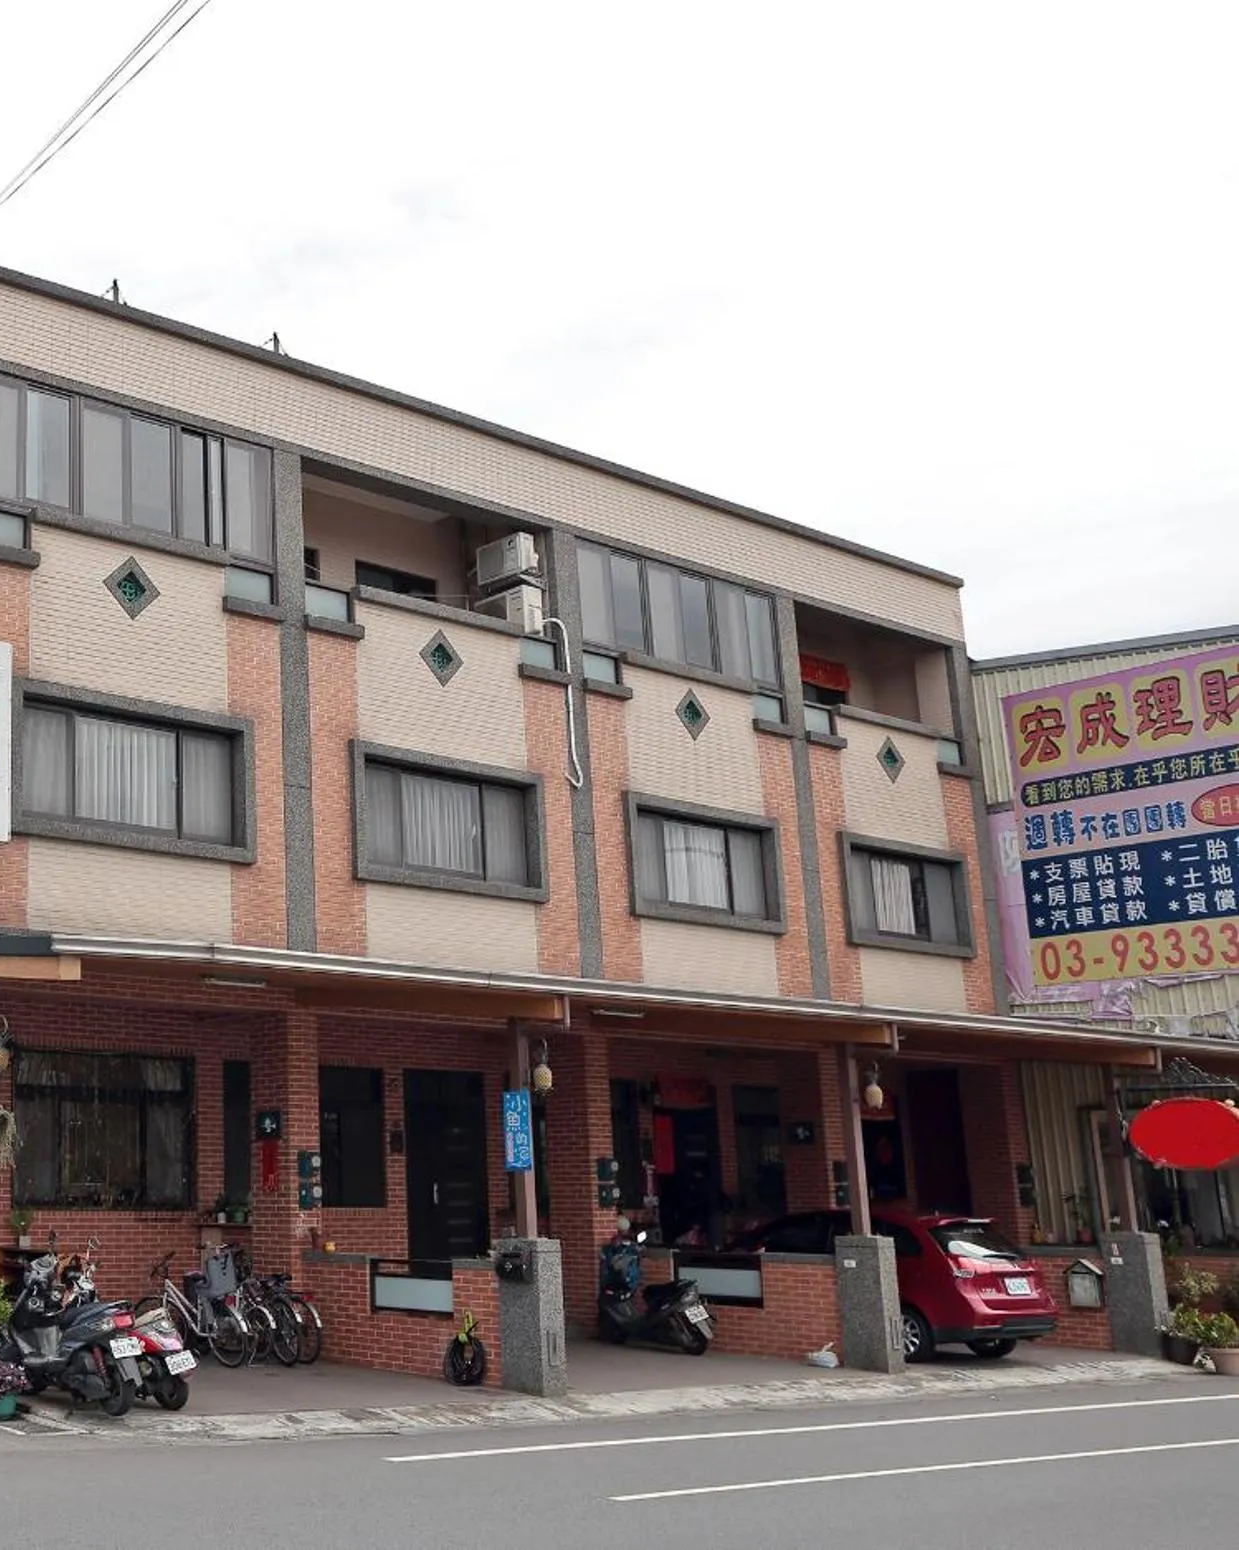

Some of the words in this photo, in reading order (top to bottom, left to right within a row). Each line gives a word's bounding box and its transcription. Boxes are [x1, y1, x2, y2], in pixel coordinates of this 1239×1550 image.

[1019, 665, 1239, 767] 宏成理財
[1179, 836, 1239, 861] 二胎
[1044, 851, 1140, 883] 支票貼現
[1048, 875, 1144, 907] 房屋貸款
[1050, 899, 1148, 931] 汽車貸款
